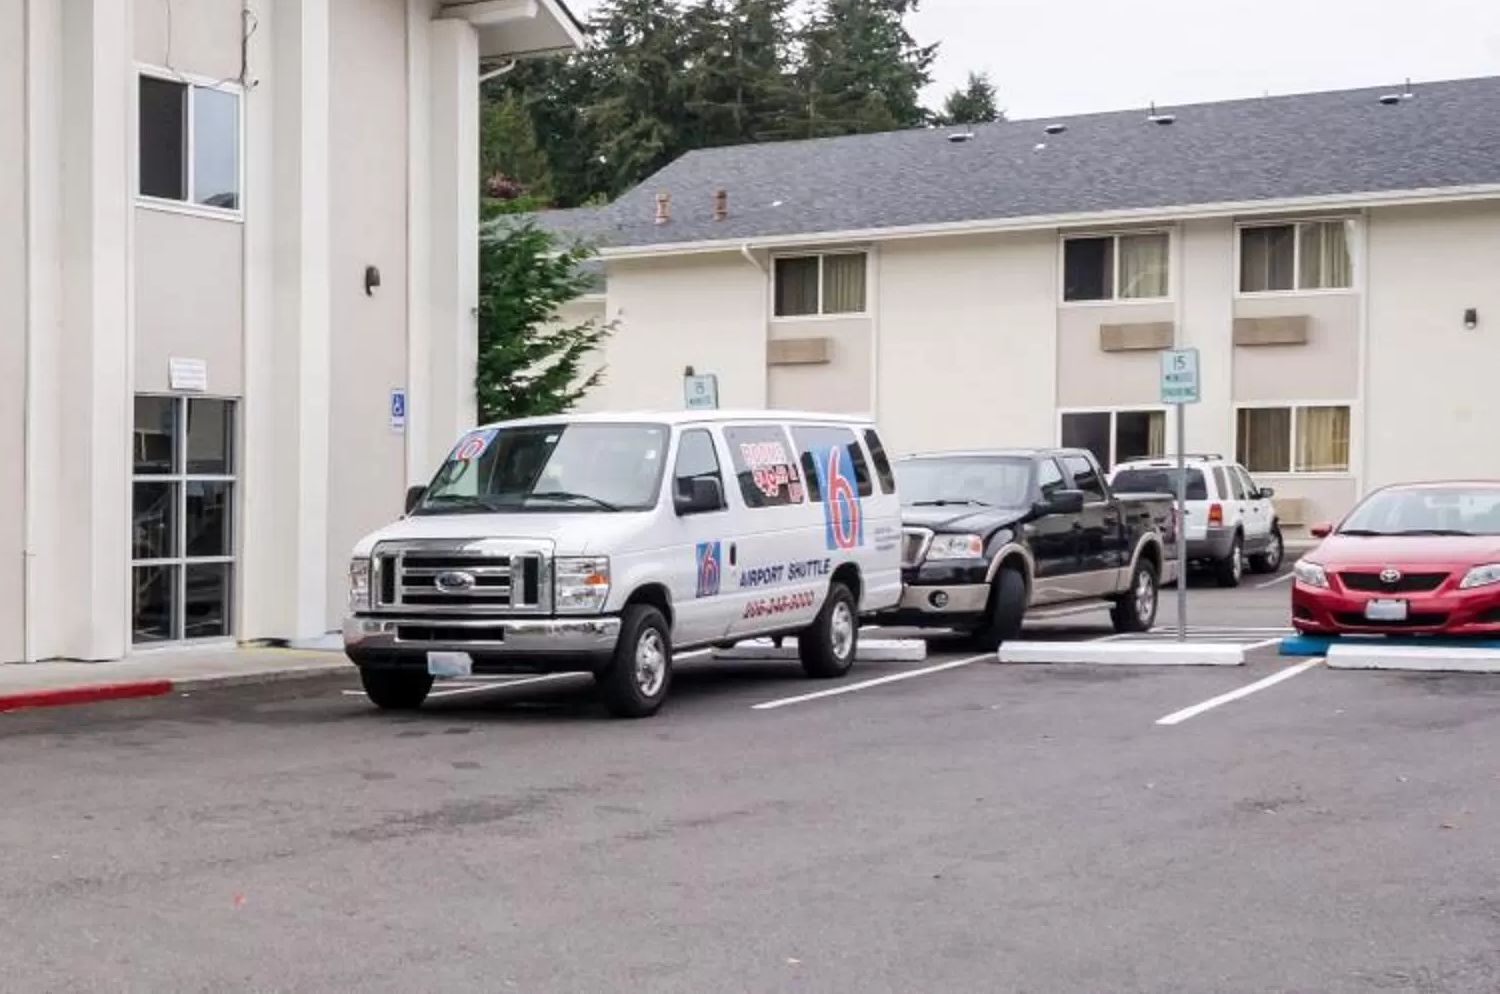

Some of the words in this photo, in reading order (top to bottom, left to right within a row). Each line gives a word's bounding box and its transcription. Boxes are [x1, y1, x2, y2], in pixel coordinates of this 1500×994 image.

[827, 446, 859, 551] 6
[740, 565, 784, 586] AIRPORT
[788, 558, 831, 580] SHUTTLE
